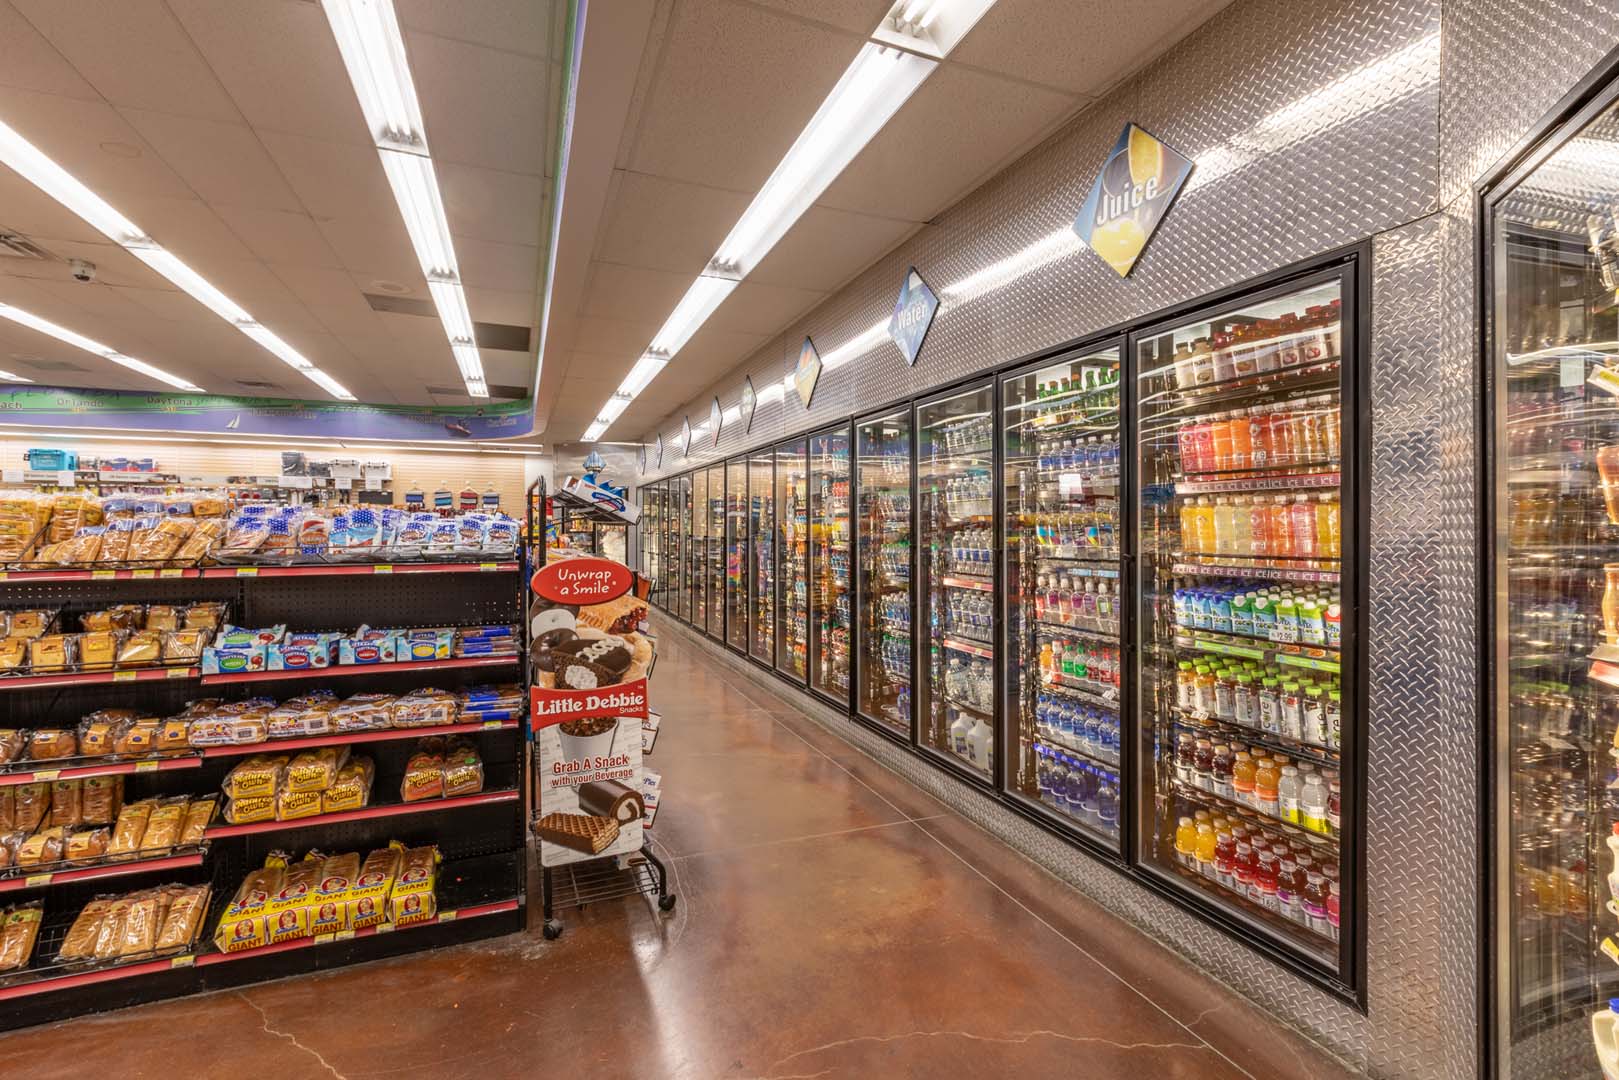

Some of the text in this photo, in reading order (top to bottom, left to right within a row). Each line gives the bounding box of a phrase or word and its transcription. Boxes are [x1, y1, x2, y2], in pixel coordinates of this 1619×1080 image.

[1097, 176, 1158, 226] Juice
[897, 303, 927, 328] Water
[0, 401, 23, 410] ach
[57, 398, 104, 408] Orlando
[147, 397, 193, 406] Daytona
[558, 568, 612, 583] Unwrap
[1319, 572, 1333, 582] ICE
[560, 580, 610, 595] a Smile
[537, 692, 644, 715] Little Debbie
[619, 706, 644, 714] Snacks
[553, 754, 629, 774] Grab A Snack
[551, 768, 633, 787] with your Beverage
[351, 886, 384, 897] GIANT
[397, 882, 429, 893] GIANT
[272, 897, 307, 909] GIANT
[353, 913, 384, 930] GIANT
[397, 912, 427, 926] GIANT
[311, 922, 343, 934] GIANT
[273, 928, 305, 944] GIANT
[227, 938, 262, 952] GIANT
